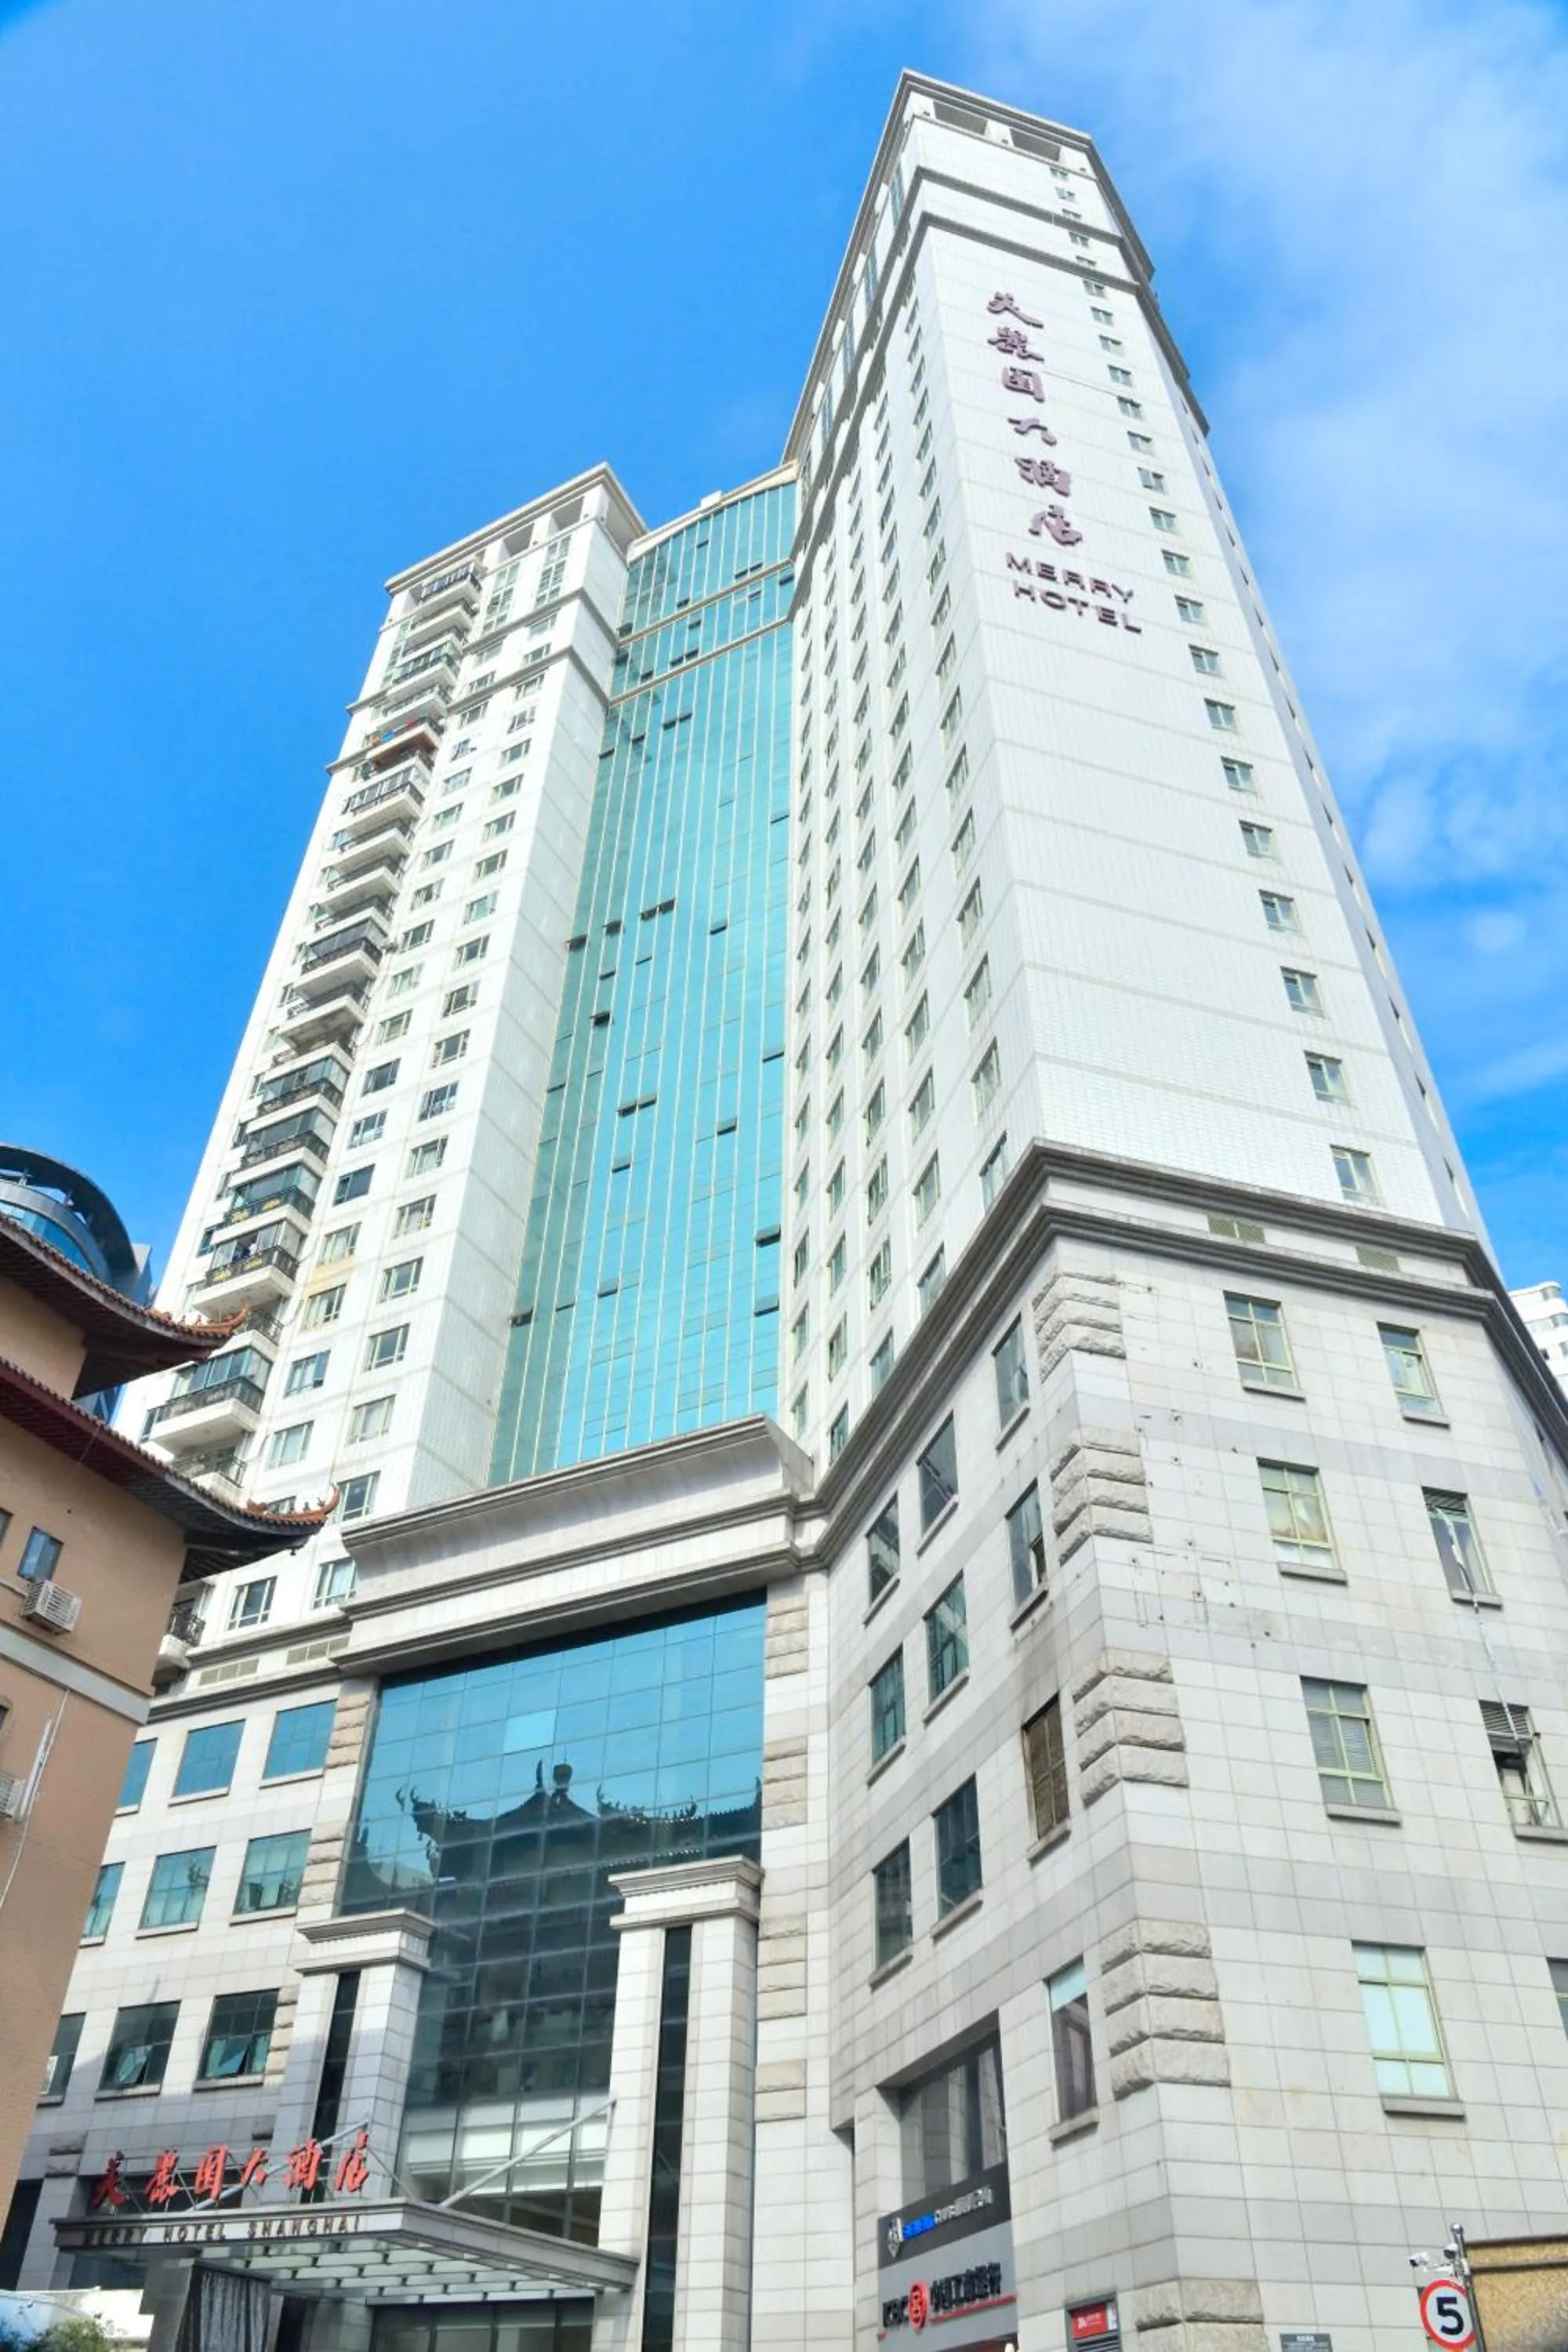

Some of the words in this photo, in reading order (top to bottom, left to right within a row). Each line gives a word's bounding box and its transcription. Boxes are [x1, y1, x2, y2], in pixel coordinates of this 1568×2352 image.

[1006, 552, 1134, 603] MERRY
[1014, 580, 1142, 633] HOTEL
[164, 2223, 227, 2243] HOTEL
[247, 2216, 361, 2239] SHANGHAI
[1436, 2296, 1465, 2336] 5
